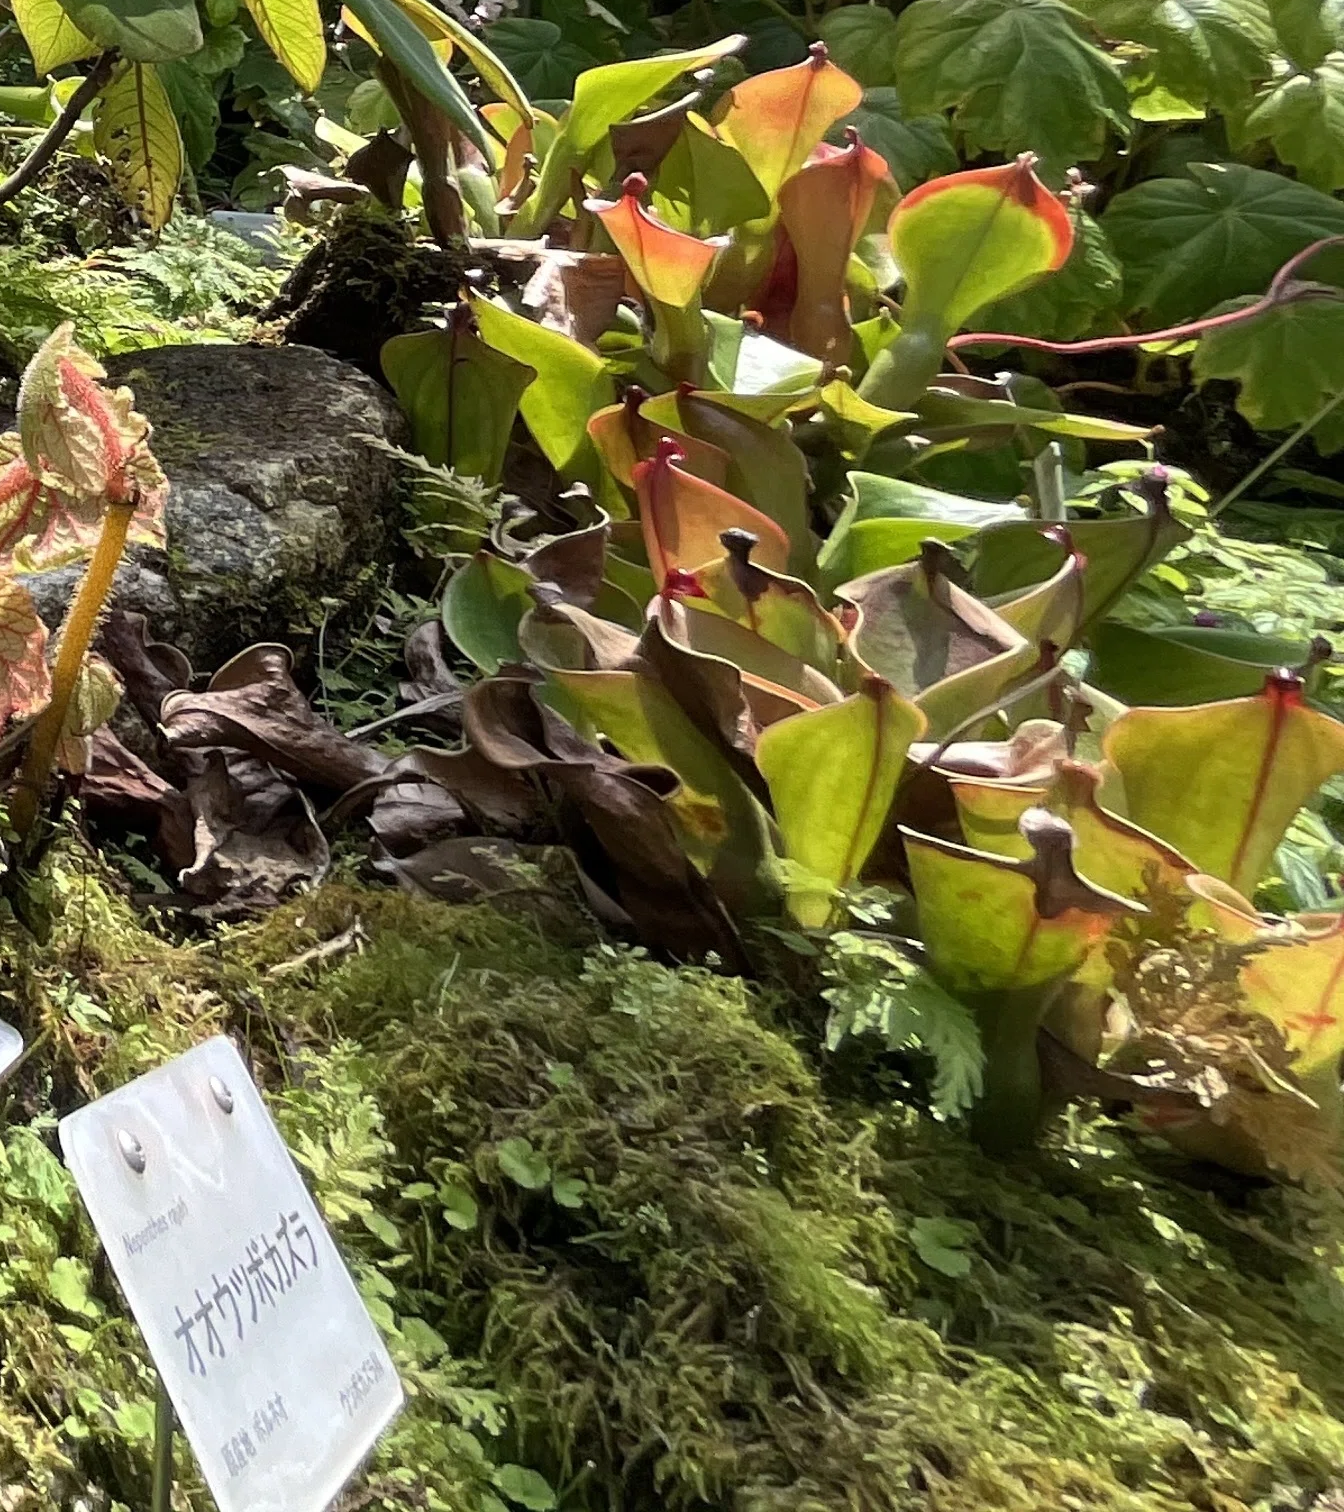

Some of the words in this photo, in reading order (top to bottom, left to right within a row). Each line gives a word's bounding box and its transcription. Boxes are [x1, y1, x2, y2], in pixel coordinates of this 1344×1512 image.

[174, 1209, 318, 1378] オオウツボカズラ
